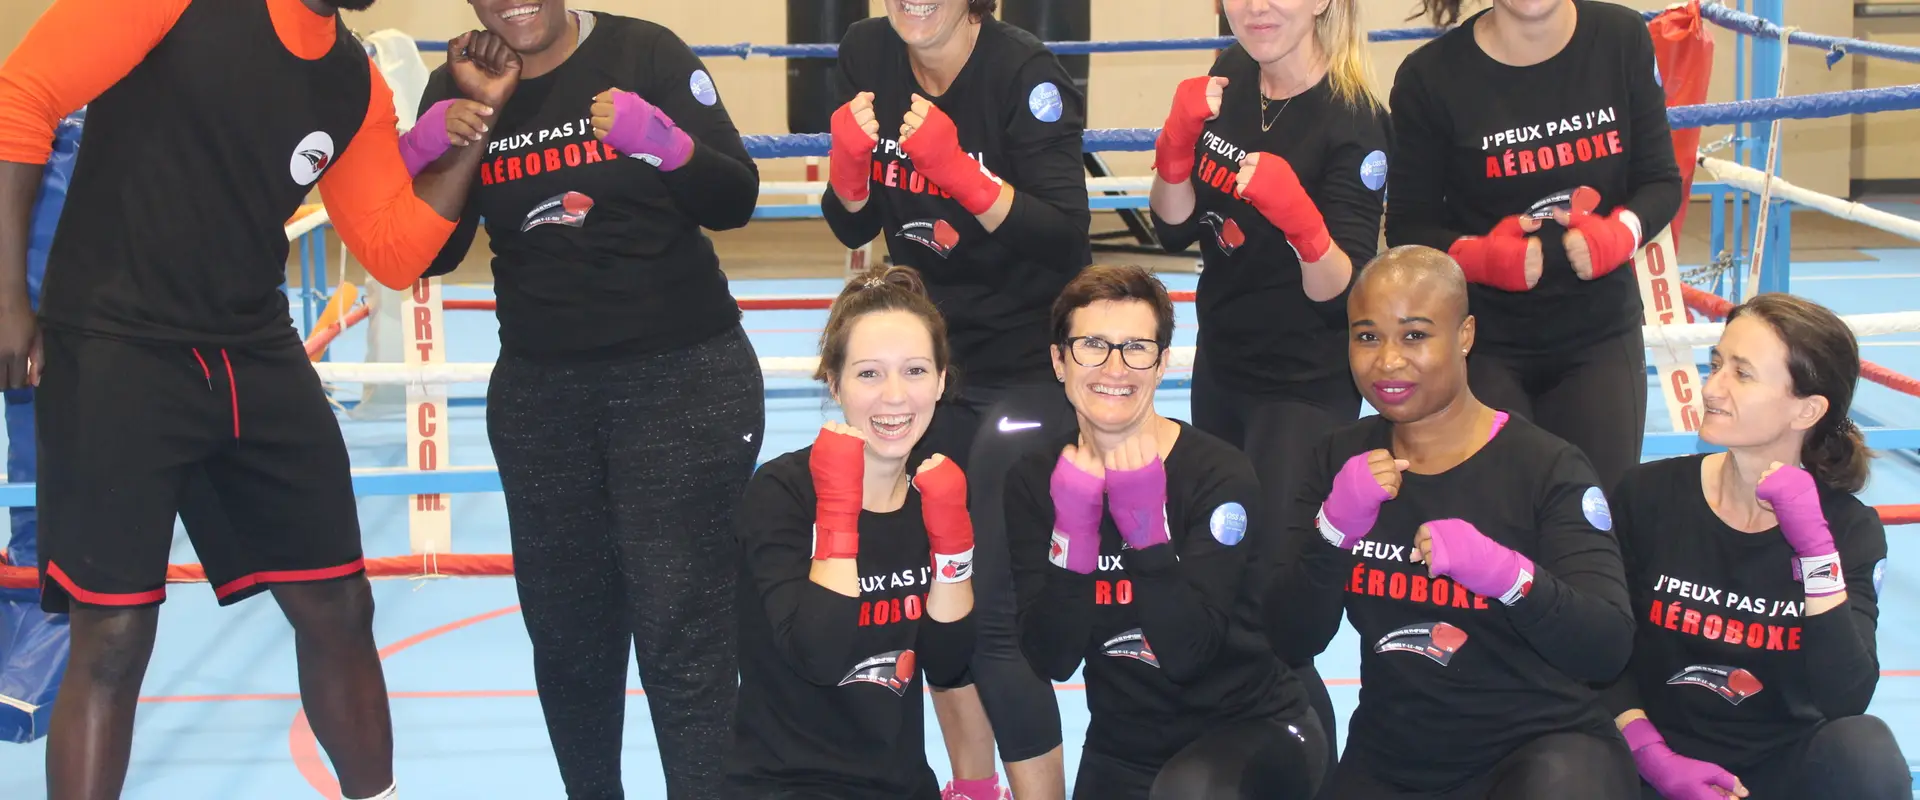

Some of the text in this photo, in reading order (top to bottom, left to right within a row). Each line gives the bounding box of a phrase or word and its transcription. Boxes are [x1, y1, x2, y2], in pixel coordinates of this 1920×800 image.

[488, 118, 591, 154] PEUX PAS J'
[1481, 106, 1617, 151] J'PEUX PAS J'AI
[481, 139, 619, 186] AÉROBOXE
[1486, 130, 1623, 178] AÉROBOXE
[412, 277, 433, 362] ORT
[1671, 369, 1700, 432] CO
[1351, 539, 1405, 562] PEUX
[890, 569, 915, 589] AS
[920, 566, 932, 586] J'
[1350, 562, 1489, 610] ÉROBOXE
[1653, 574, 1722, 606] J'PEUX
[1725, 592, 1766, 614] PAS
[858, 594, 923, 627] ROBO
[1649, 599, 1803, 652] AÉROBOXE
